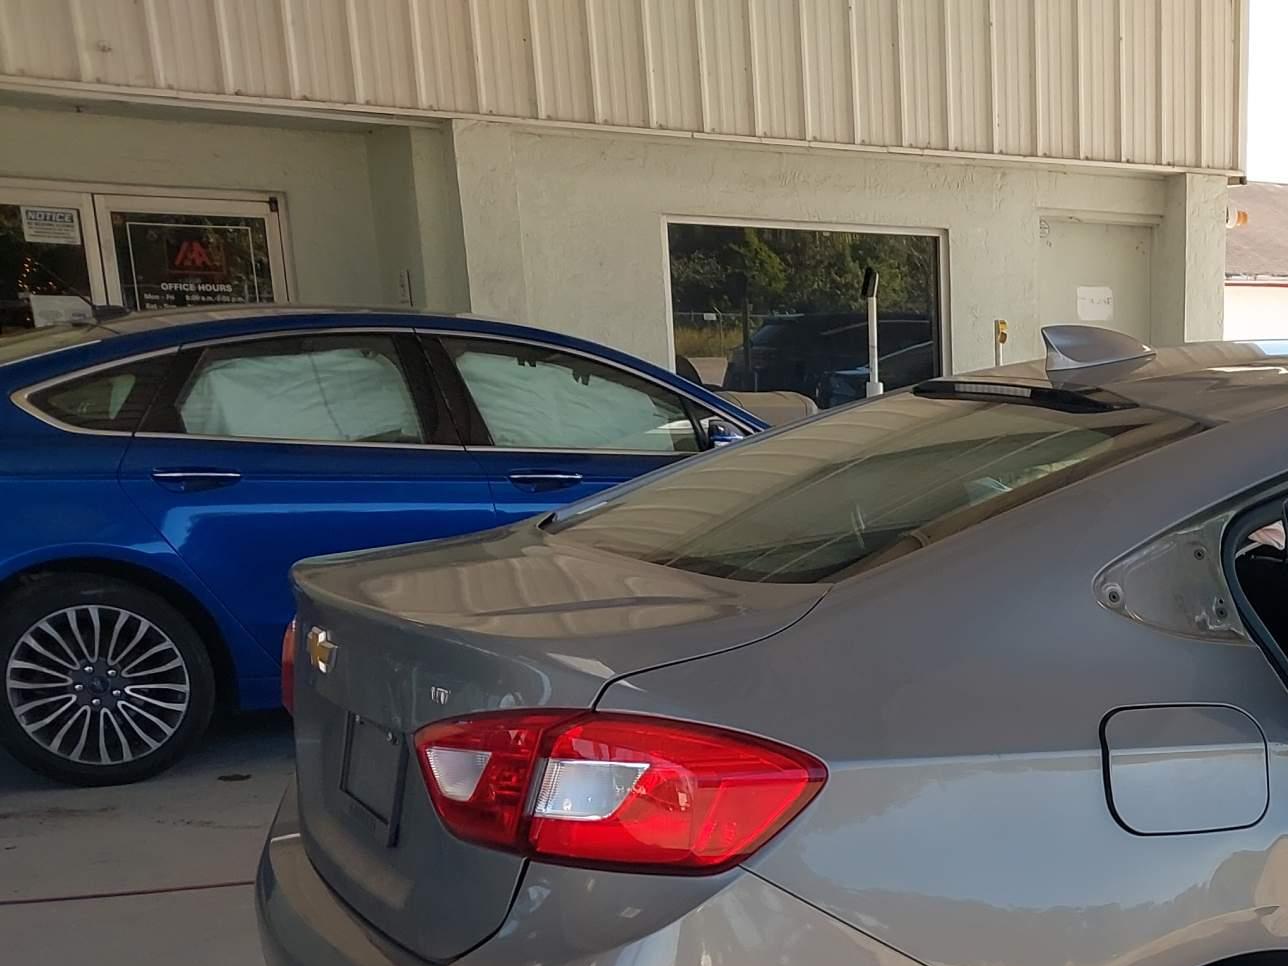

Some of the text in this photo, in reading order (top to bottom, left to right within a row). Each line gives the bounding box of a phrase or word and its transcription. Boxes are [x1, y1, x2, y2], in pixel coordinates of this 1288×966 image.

[27, 211, 72, 223] NOTICE
[160, 282, 233, 292] OFFICE HOURS
